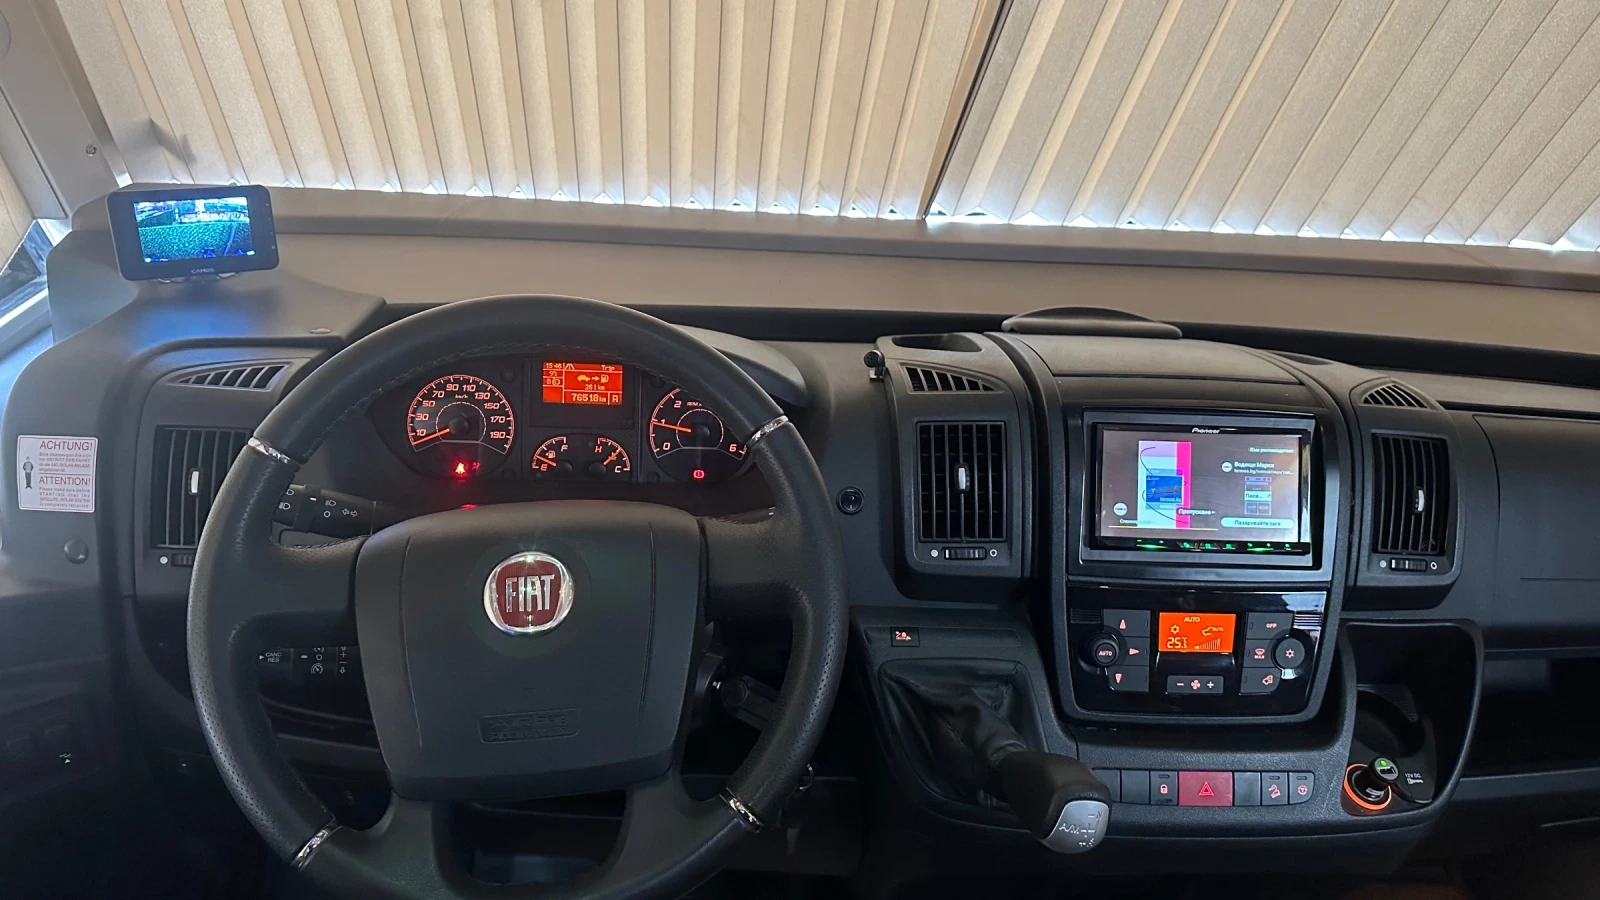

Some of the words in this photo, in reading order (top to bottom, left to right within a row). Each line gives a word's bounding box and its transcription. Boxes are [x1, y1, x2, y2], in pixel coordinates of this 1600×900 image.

[462, 384, 476, 392] 110
[432, 390, 445, 398] 70
[474, 392, 490, 400] 130
[612, 395, 619, 403] R
[484, 402, 500, 410] 150
[674, 400, 682, 408] 2
[416, 413, 429, 421] 30
[416, 429, 427, 437] 10
[490, 431, 506, 439] 190
[40, 440, 93, 451] ACHTUNG!
[561, 444, 568, 452] F
[663, 442, 671, 451] 0
[729, 444, 737, 452] 6
[540, 463, 548, 471] E
[614, 465, 622, 473] C
[39, 476, 91, 486] ATTENTION!
[505, 573, 555, 612] FIAT
